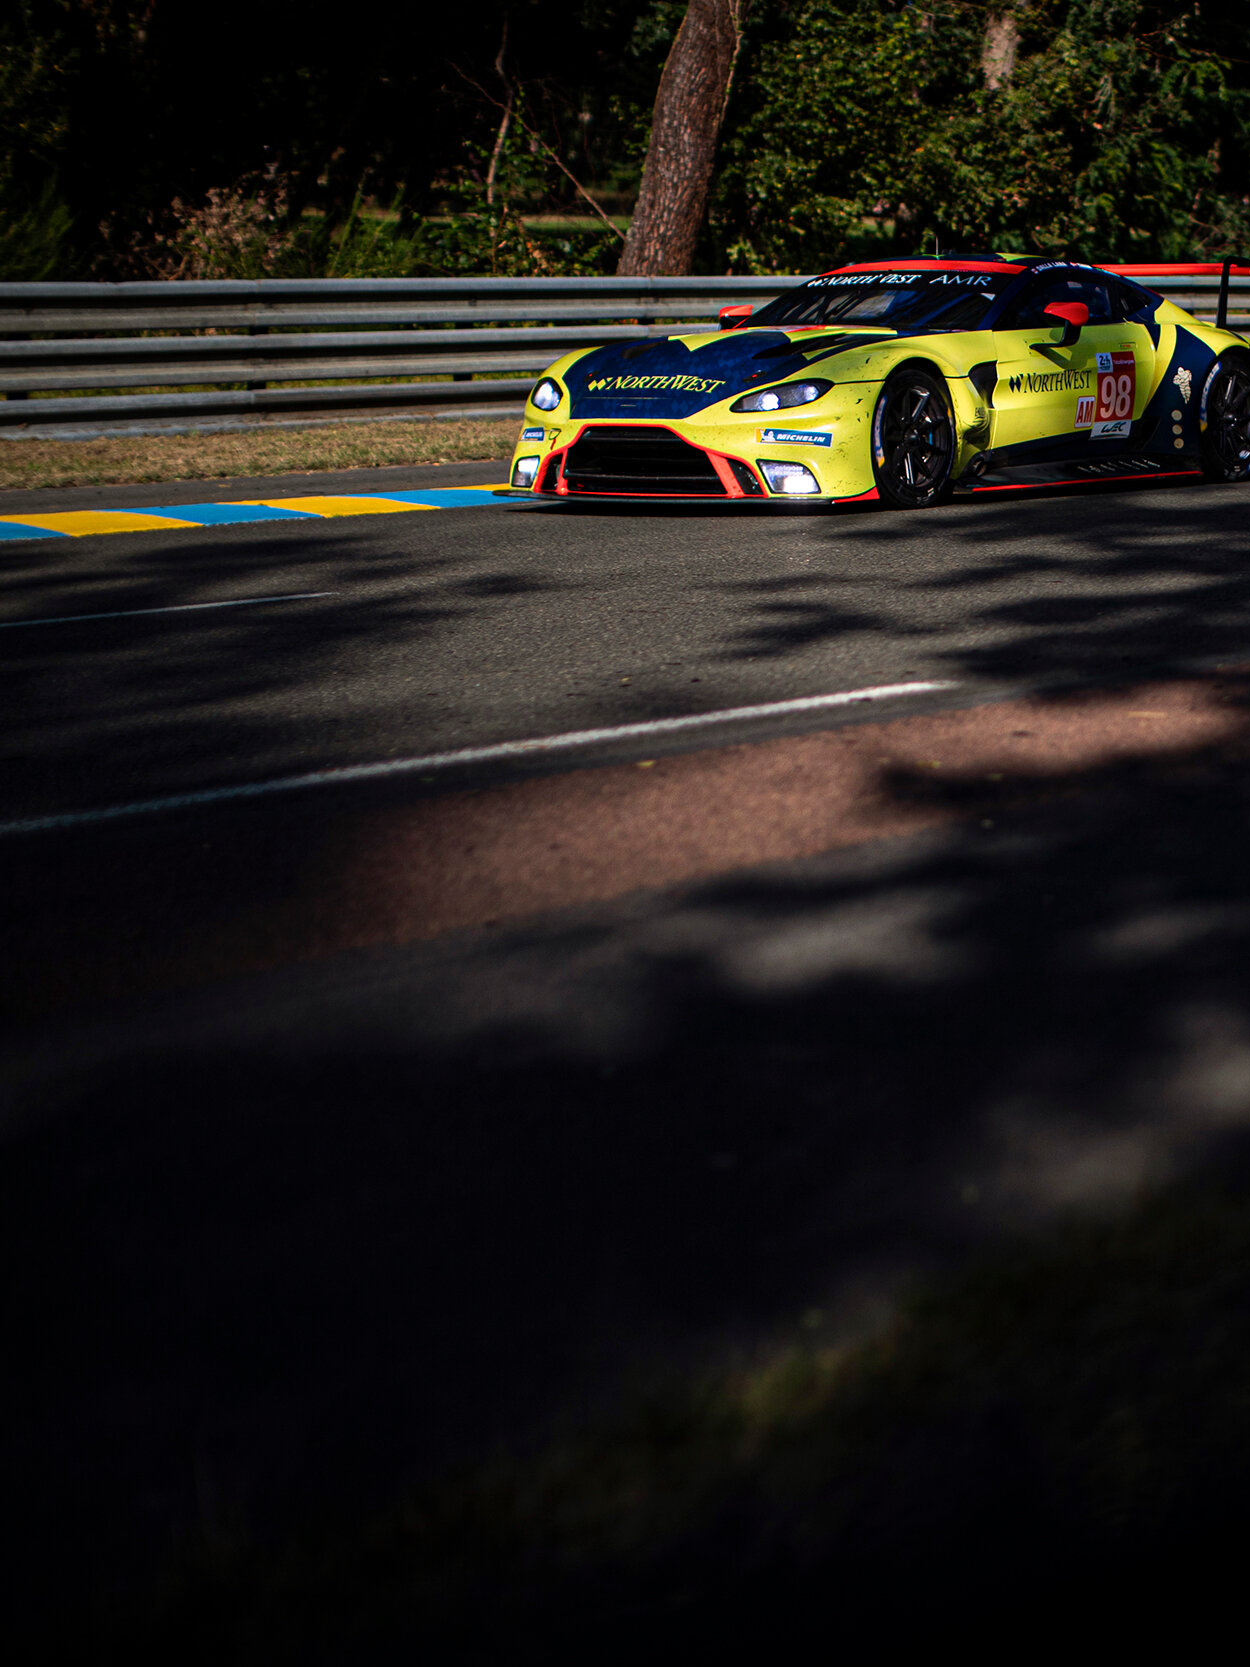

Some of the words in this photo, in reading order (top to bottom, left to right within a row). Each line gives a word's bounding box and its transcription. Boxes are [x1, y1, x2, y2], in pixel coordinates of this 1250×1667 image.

[929, 274, 992, 287] AMR
[606, 375, 726, 393] NORTHWEST
[1024, 369, 1092, 393] NORTHWEST
[1100, 375, 1132, 418] 98
[1077, 401, 1094, 424] AM
[1101, 421, 1127, 433] WEC
[776, 433, 826, 443] MICHELIN
